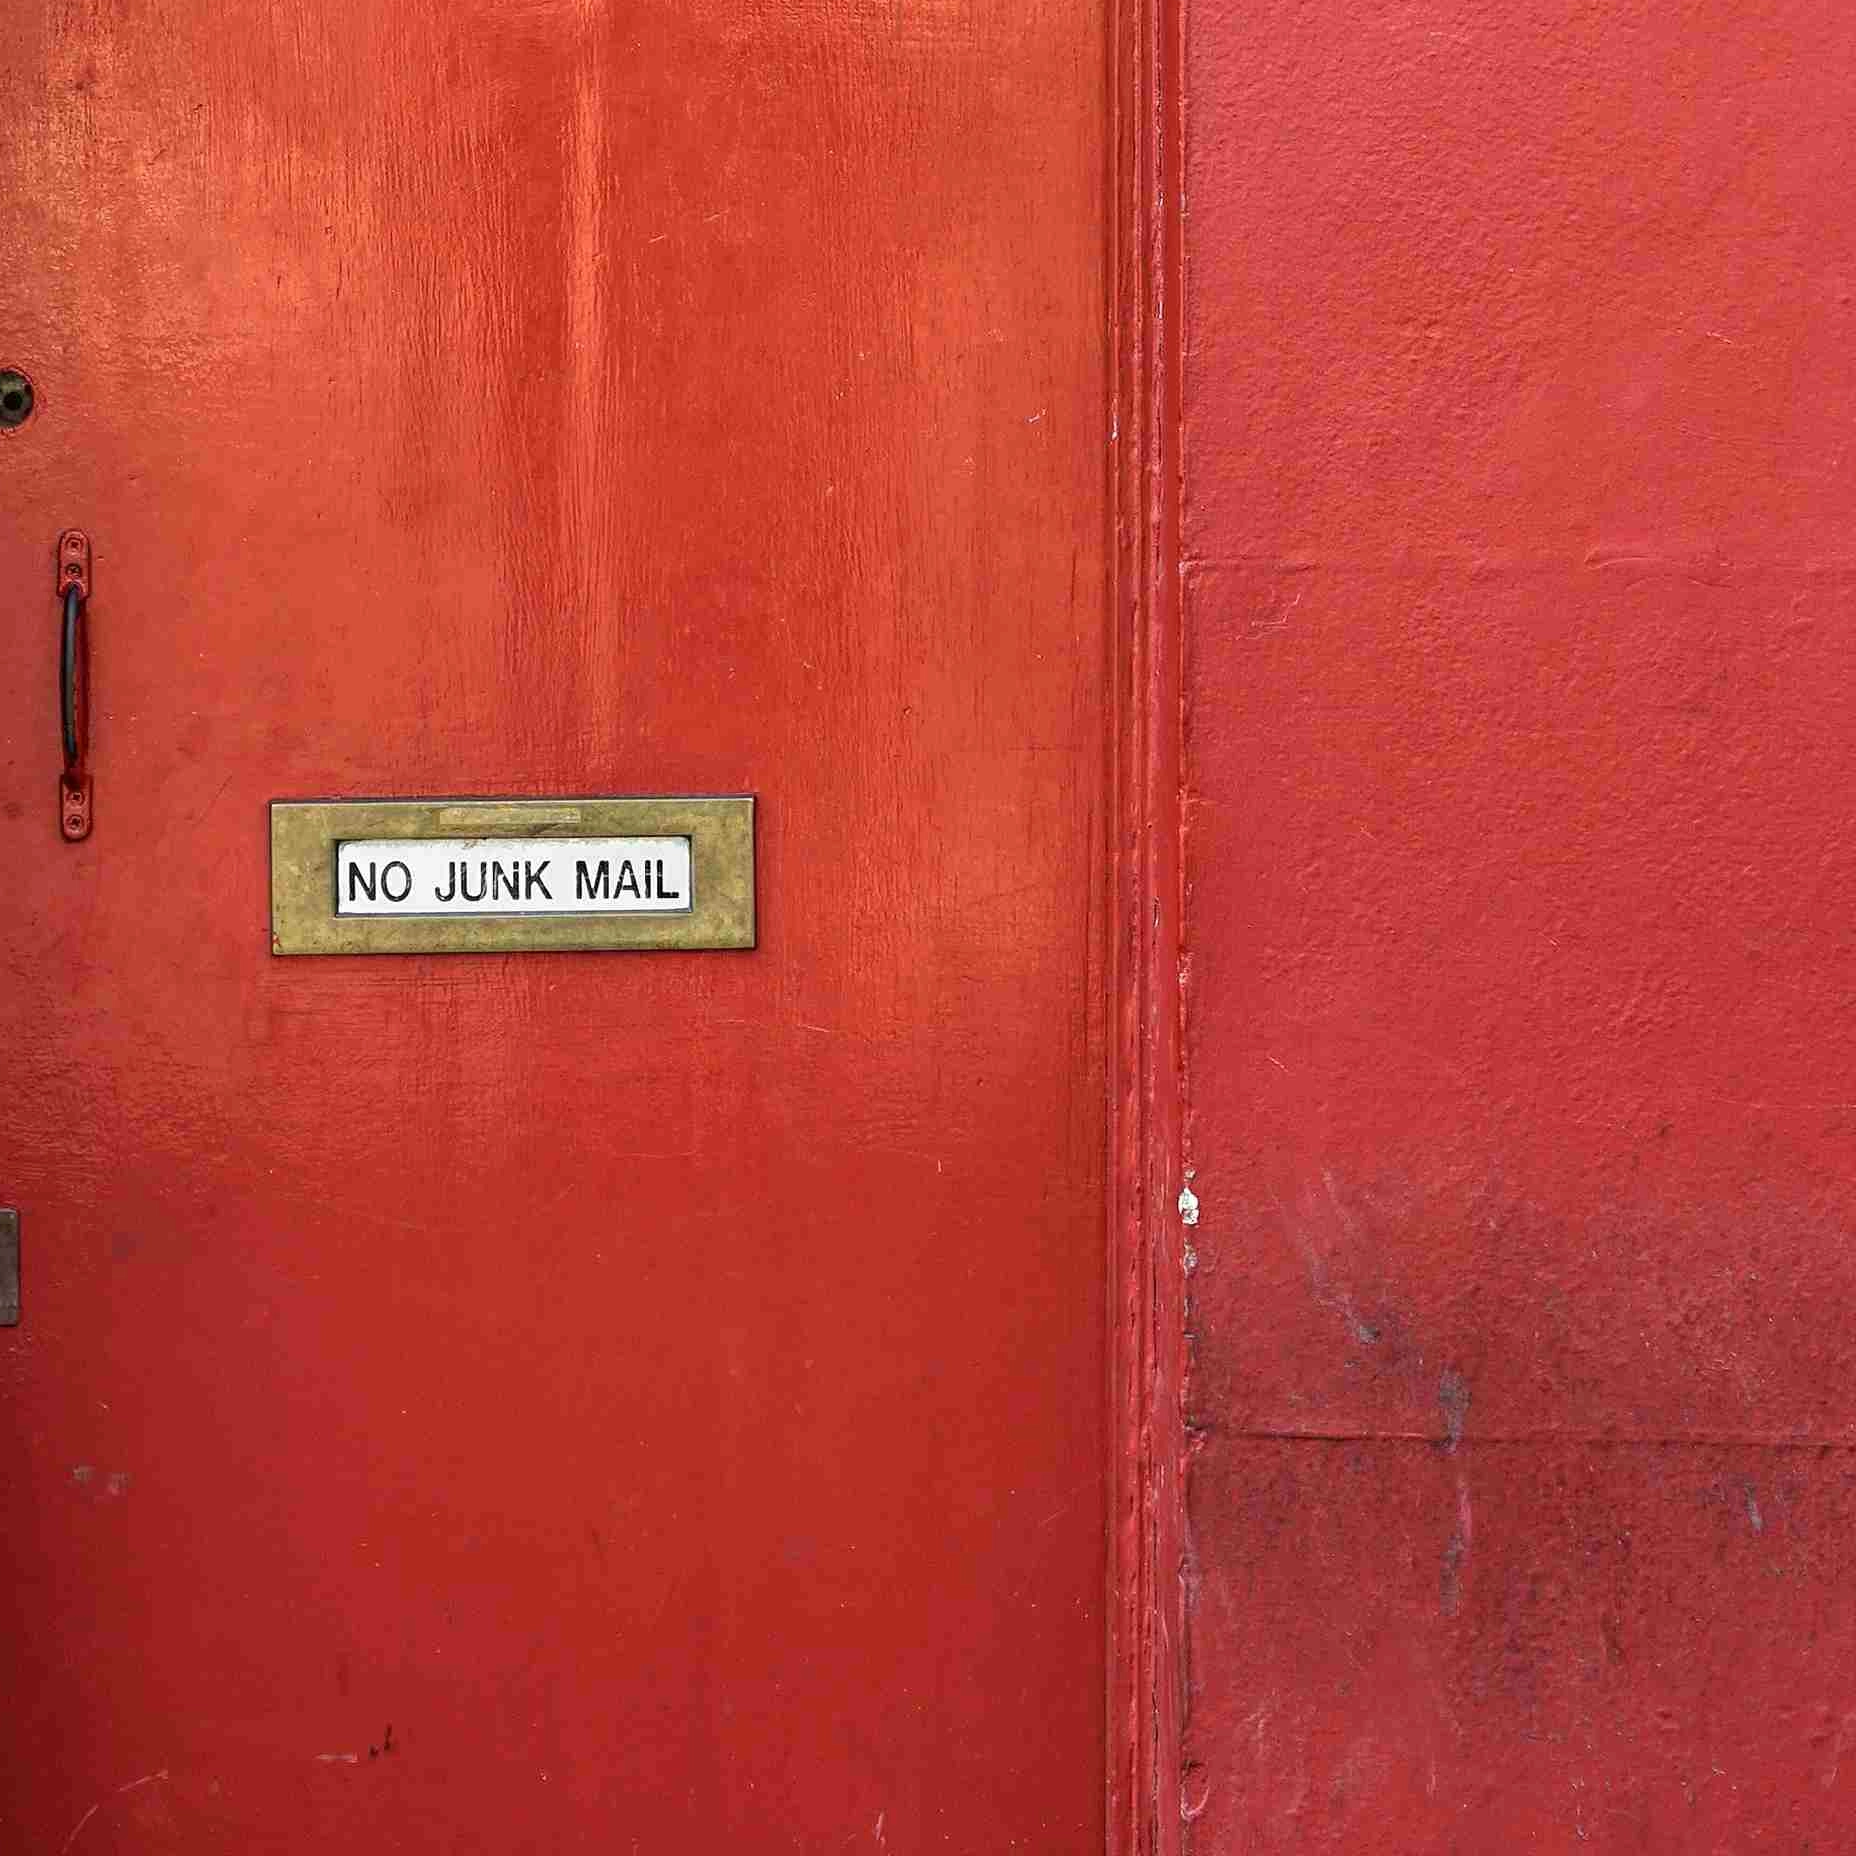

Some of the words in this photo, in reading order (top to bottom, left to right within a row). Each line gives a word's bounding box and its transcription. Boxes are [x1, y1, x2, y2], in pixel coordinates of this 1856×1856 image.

[348, 859, 412, 903] NO
[434, 860, 553, 902] JUNK
[575, 858, 681, 900] MAIL
